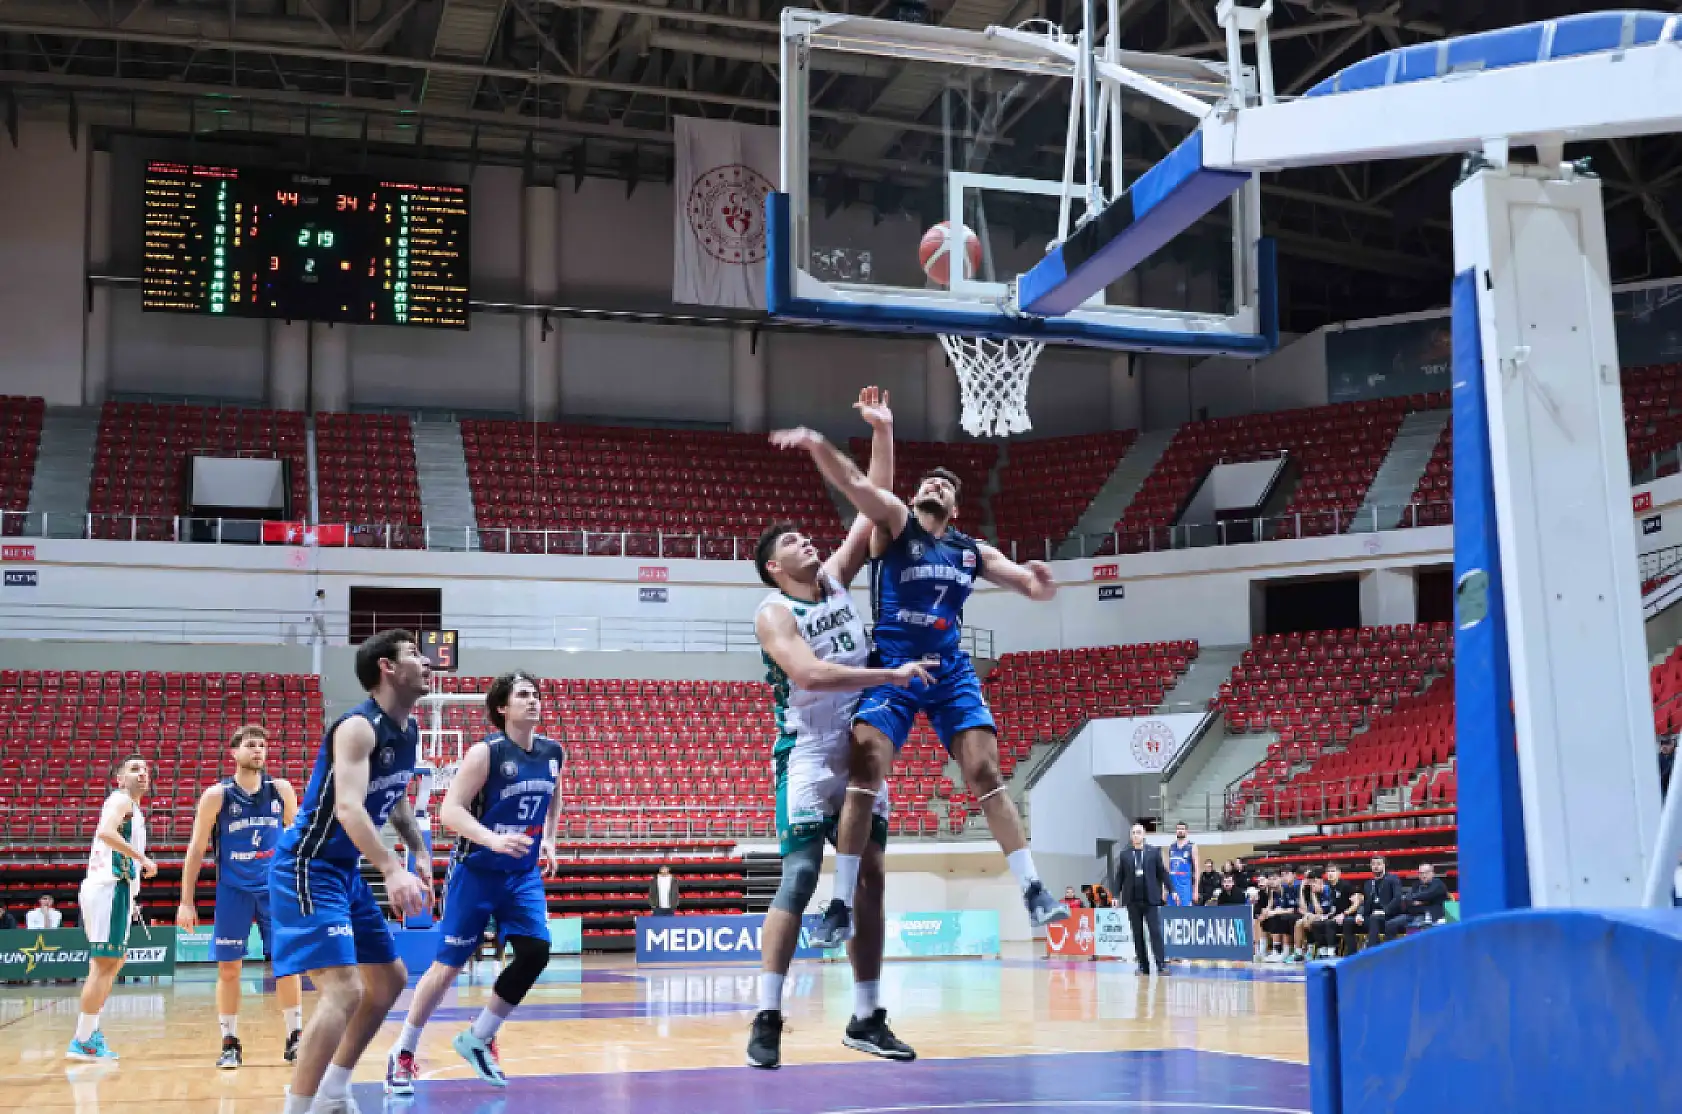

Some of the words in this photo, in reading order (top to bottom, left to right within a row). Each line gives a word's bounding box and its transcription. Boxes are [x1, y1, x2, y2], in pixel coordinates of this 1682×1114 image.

[277, 190, 298, 207] 44
[336, 195, 358, 212] 34
[298, 229, 311, 247] 2
[934, 585, 949, 610] 7
[438, 645, 450, 667] 5
[517, 795, 543, 820] 57
[251, 829, 262, 848] 4
[645, 926, 763, 952] MEDICA
[1163, 918, 1237, 946] MEDICANA
